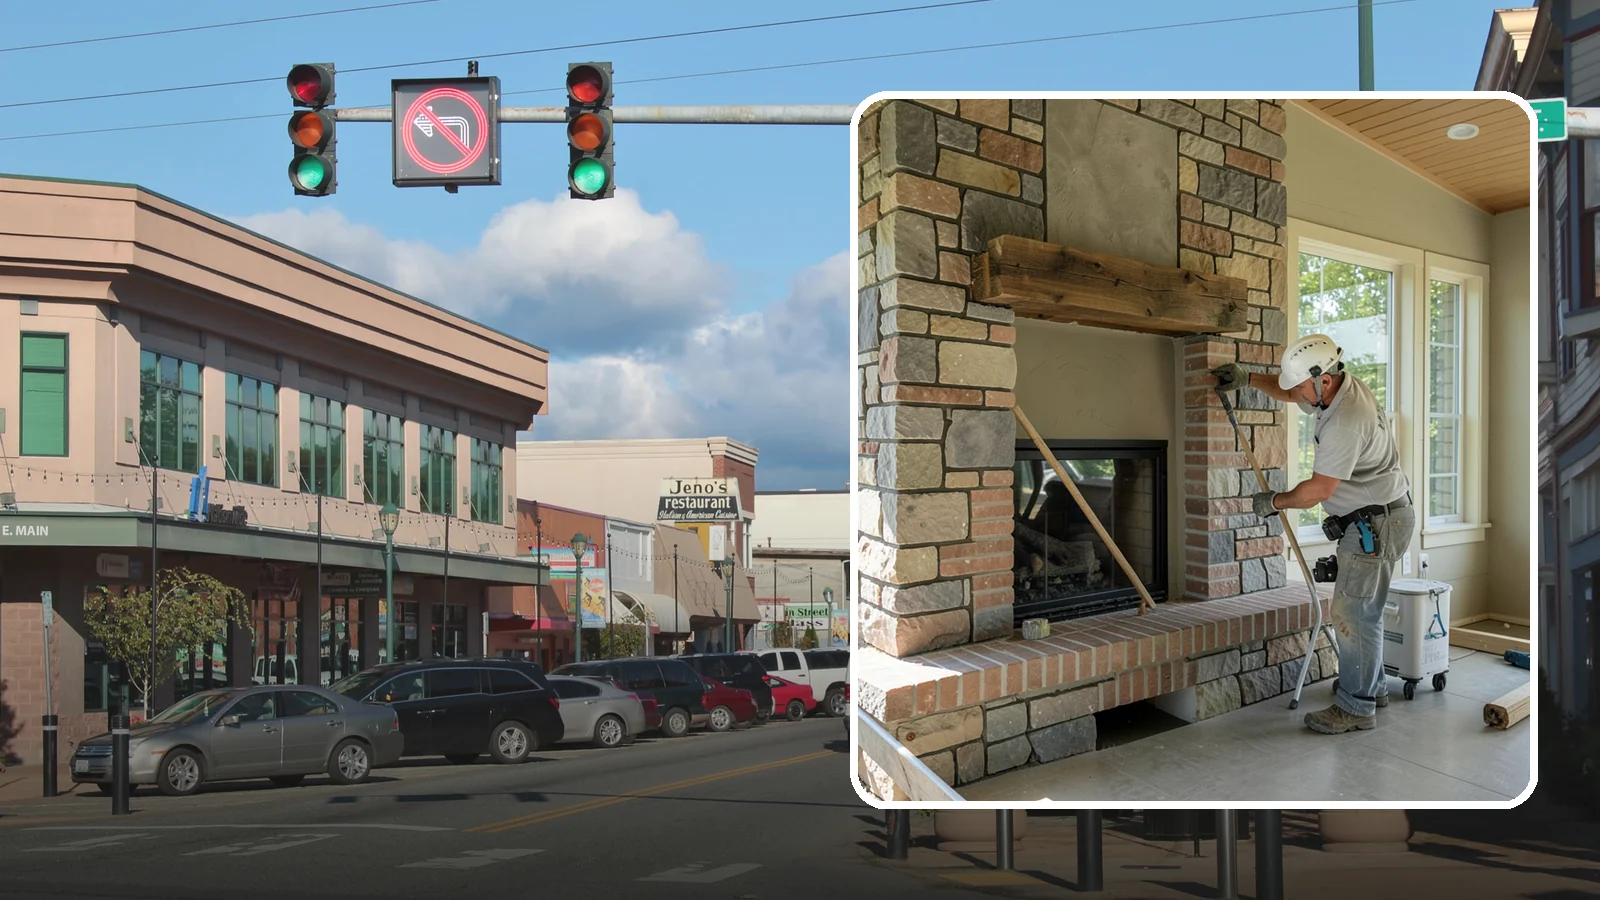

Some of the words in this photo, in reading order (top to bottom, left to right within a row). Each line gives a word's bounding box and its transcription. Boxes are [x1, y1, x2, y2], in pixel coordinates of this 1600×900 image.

[669, 480, 728, 494] Jeno's
[665, 496, 731, 509] restaurant
[658, 510, 681, 520] Italian
[686, 510, 714, 519] American
[715, 510, 738, 519] Cuisine
[2, 525, 13, 536] E.
[15, 525, 49, 536] MAIN
[786, 608, 795, 616] in
[797, 607, 828, 616] Street
